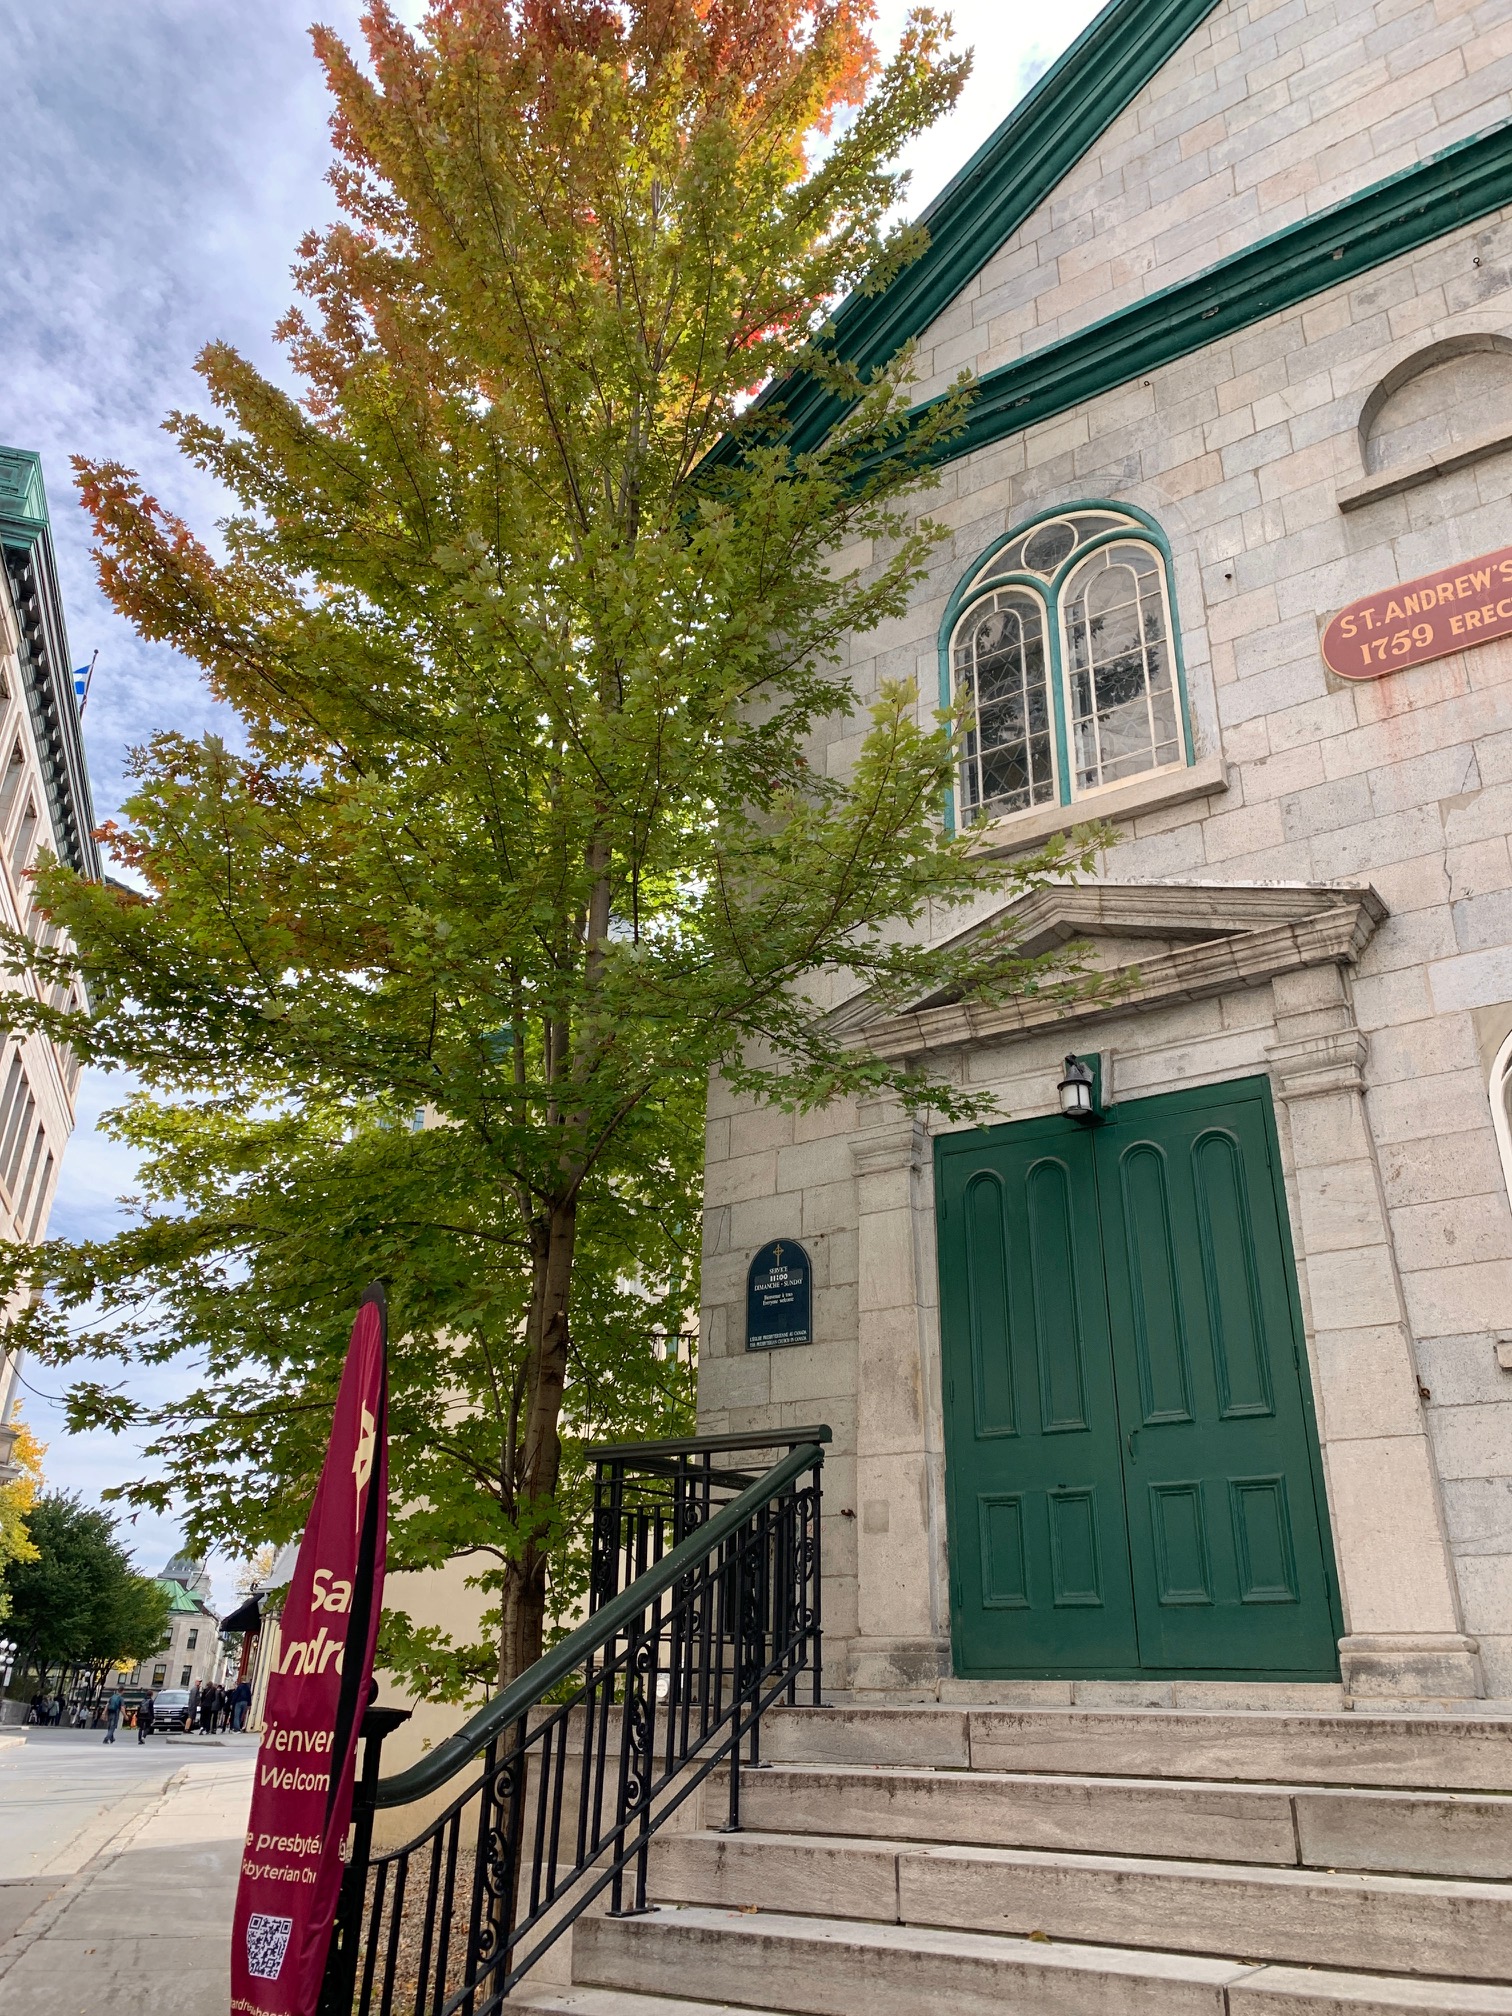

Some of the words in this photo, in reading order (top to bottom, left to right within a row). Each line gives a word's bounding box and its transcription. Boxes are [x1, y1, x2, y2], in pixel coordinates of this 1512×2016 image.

[1359, 623, 1434, 666] 1759
[1448, 596, 1512, 636] EREC
[769, 1266, 788, 1274] SERVICE
[770, 1273, 788, 1282] 11:00
[754, 1282, 780, 1291] DIMANCHE
[783, 1278, 803, 1287] SUNDAY
[261, 1764, 331, 1792] Welcom
